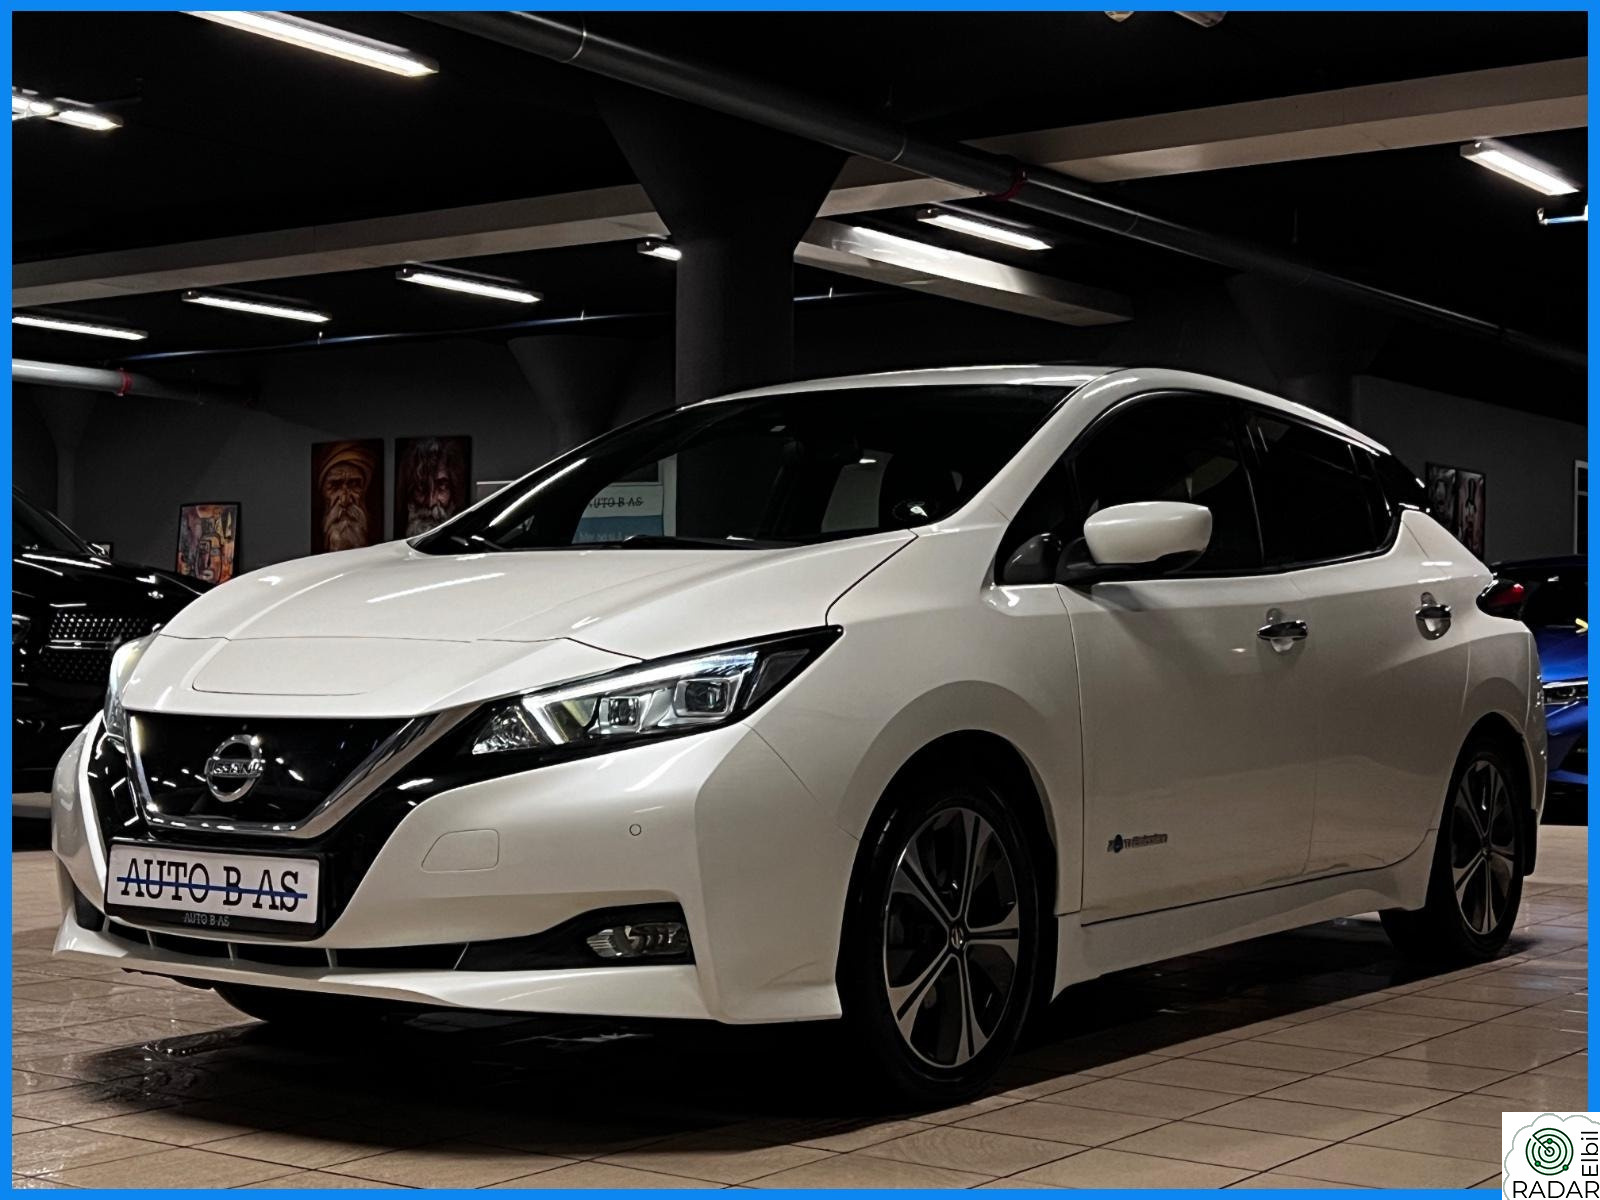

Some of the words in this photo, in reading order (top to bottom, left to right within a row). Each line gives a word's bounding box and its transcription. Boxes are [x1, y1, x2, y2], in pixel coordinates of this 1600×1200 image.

[618, 496, 625, 508] B
[121, 858, 210, 903] AUTO
[223, 866, 243, 906] B
[252, 869, 299, 912] AS
[183, 911, 208, 925] AUTO
[209, 914, 216, 926] B
[217, 915, 230, 927] AS
